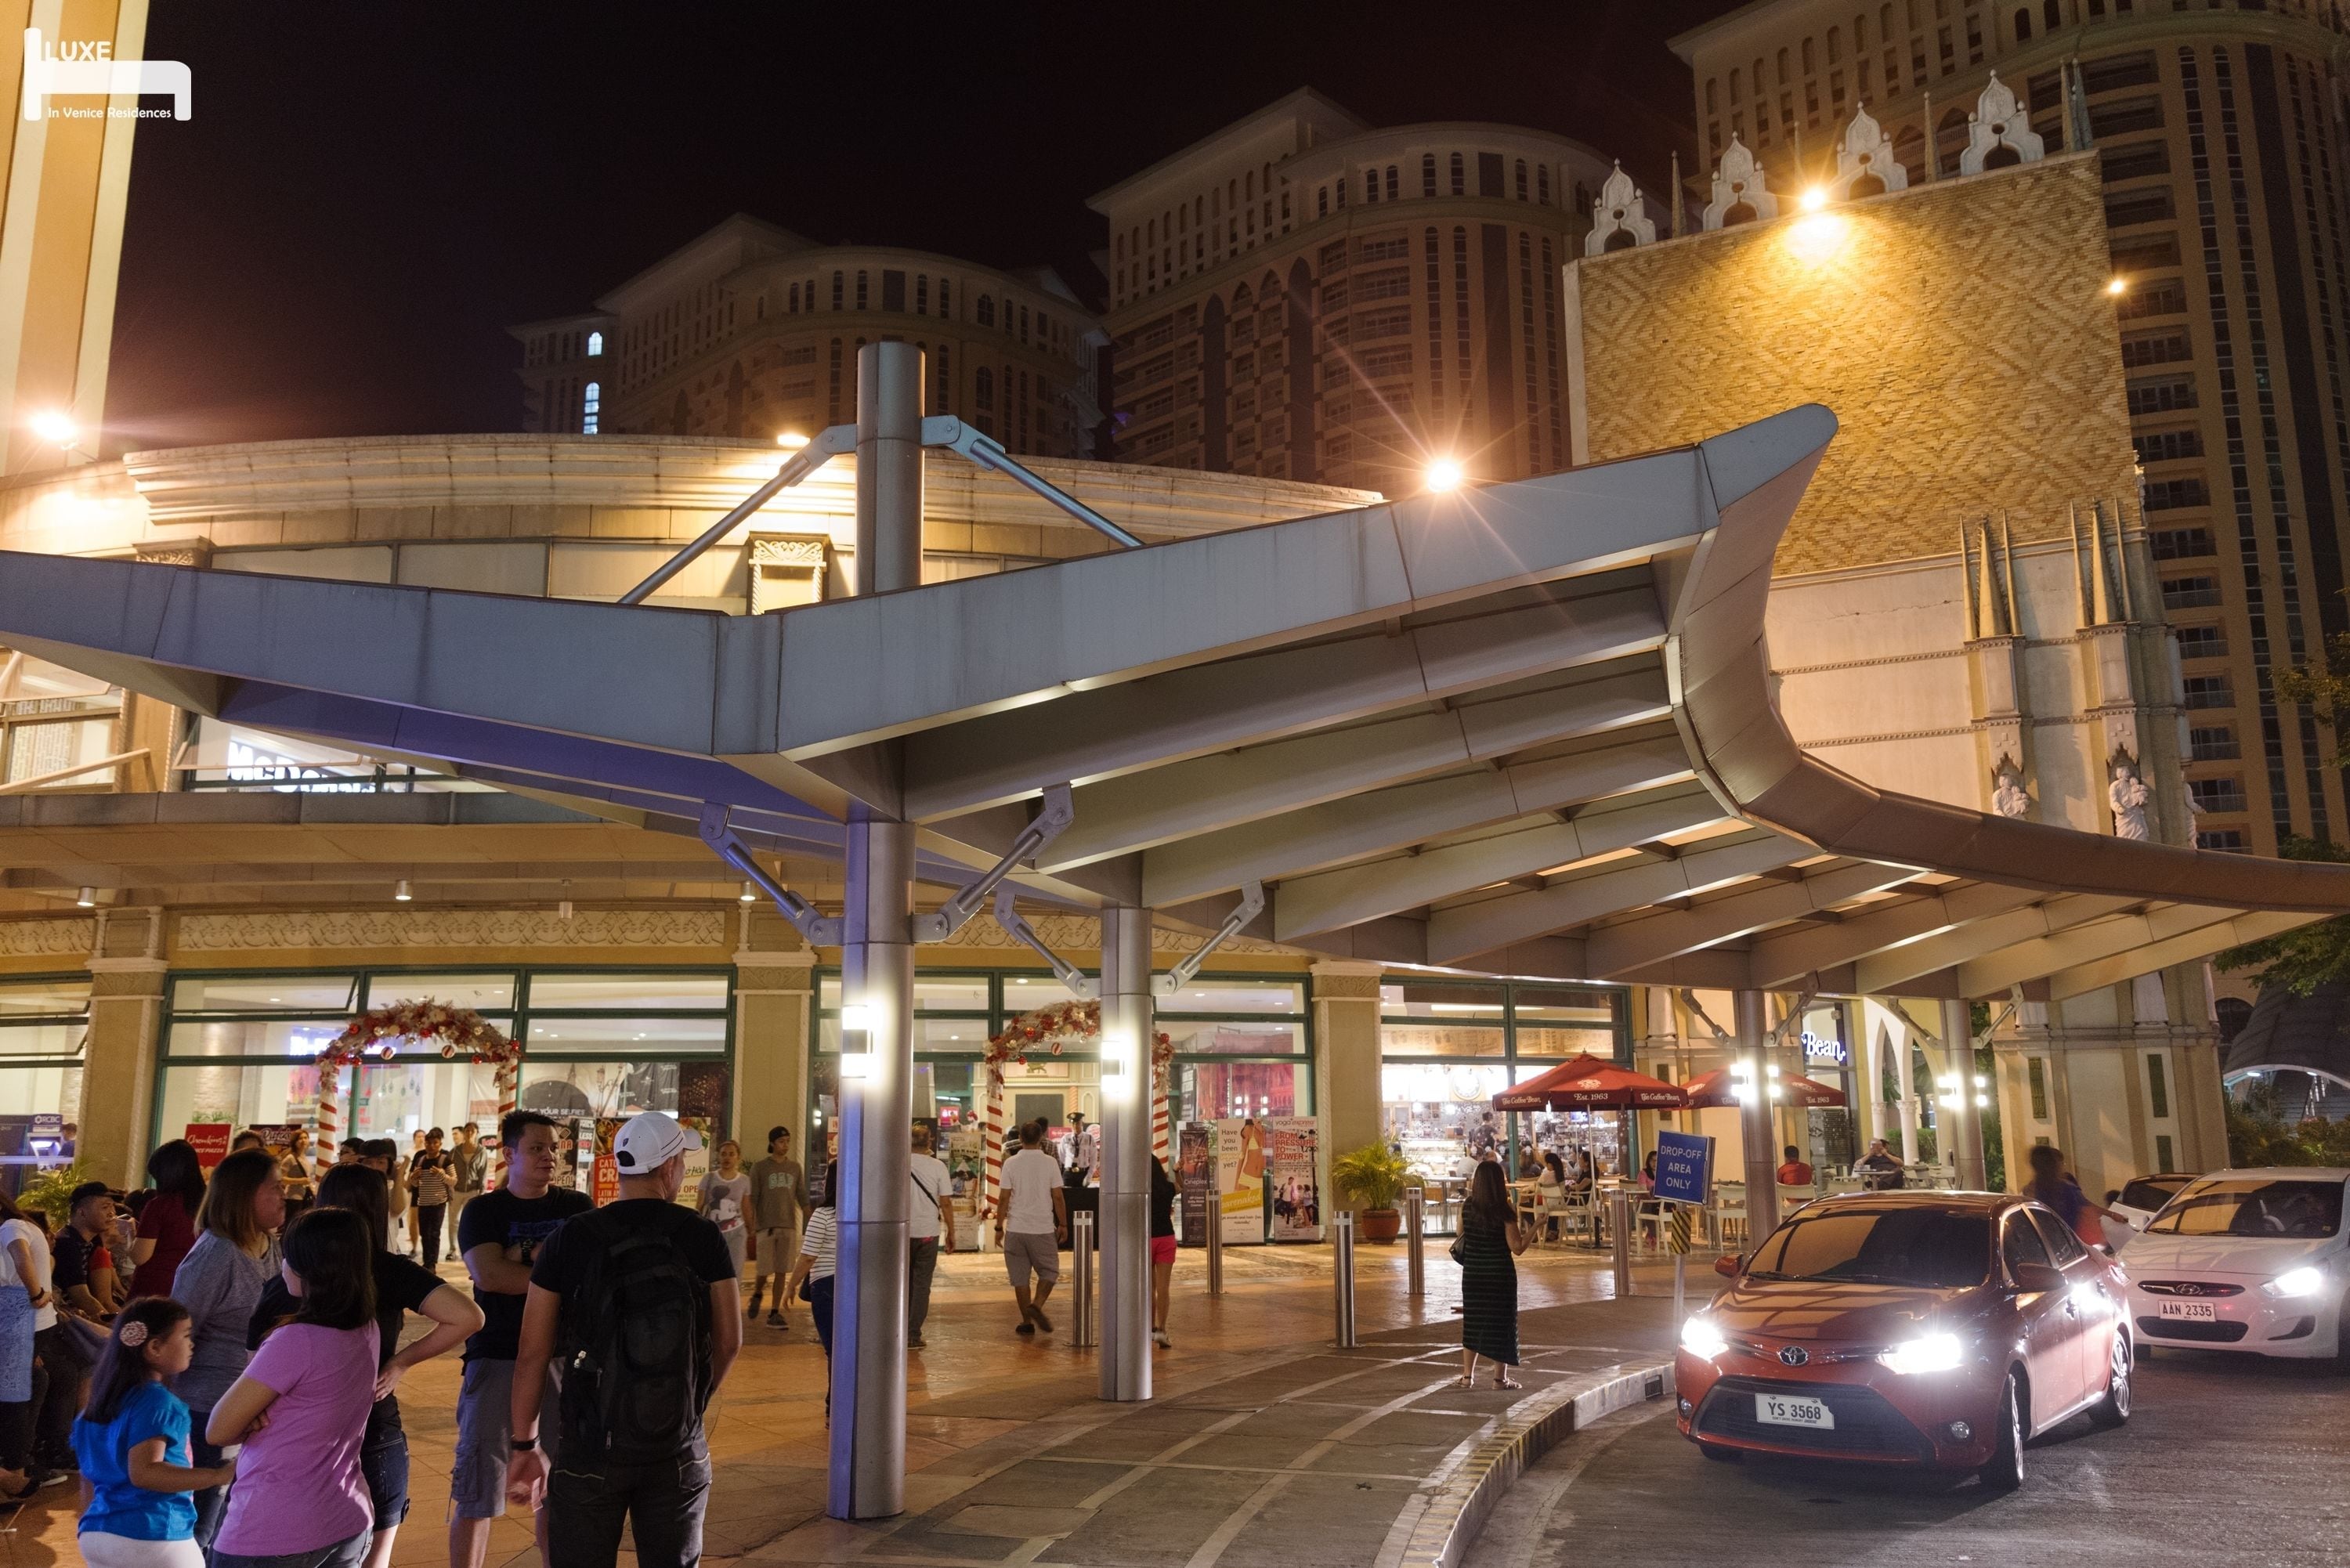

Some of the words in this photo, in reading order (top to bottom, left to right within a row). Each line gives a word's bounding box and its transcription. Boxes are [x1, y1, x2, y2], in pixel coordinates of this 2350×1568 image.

[1802, 1031, 1846, 1061] Bean
[1661, 1146, 1701, 1159] DROP-OFF
[1668, 1162, 1691, 1174] AREA
[1666, 1177, 1691, 1190] ONLY
[2163, 1303, 2182, 1315] AAN
[2186, 1304, 2212, 1317] 2335
[1768, 1402, 1785, 1416] YS
[1791, 1404, 1821, 1420] 3568
